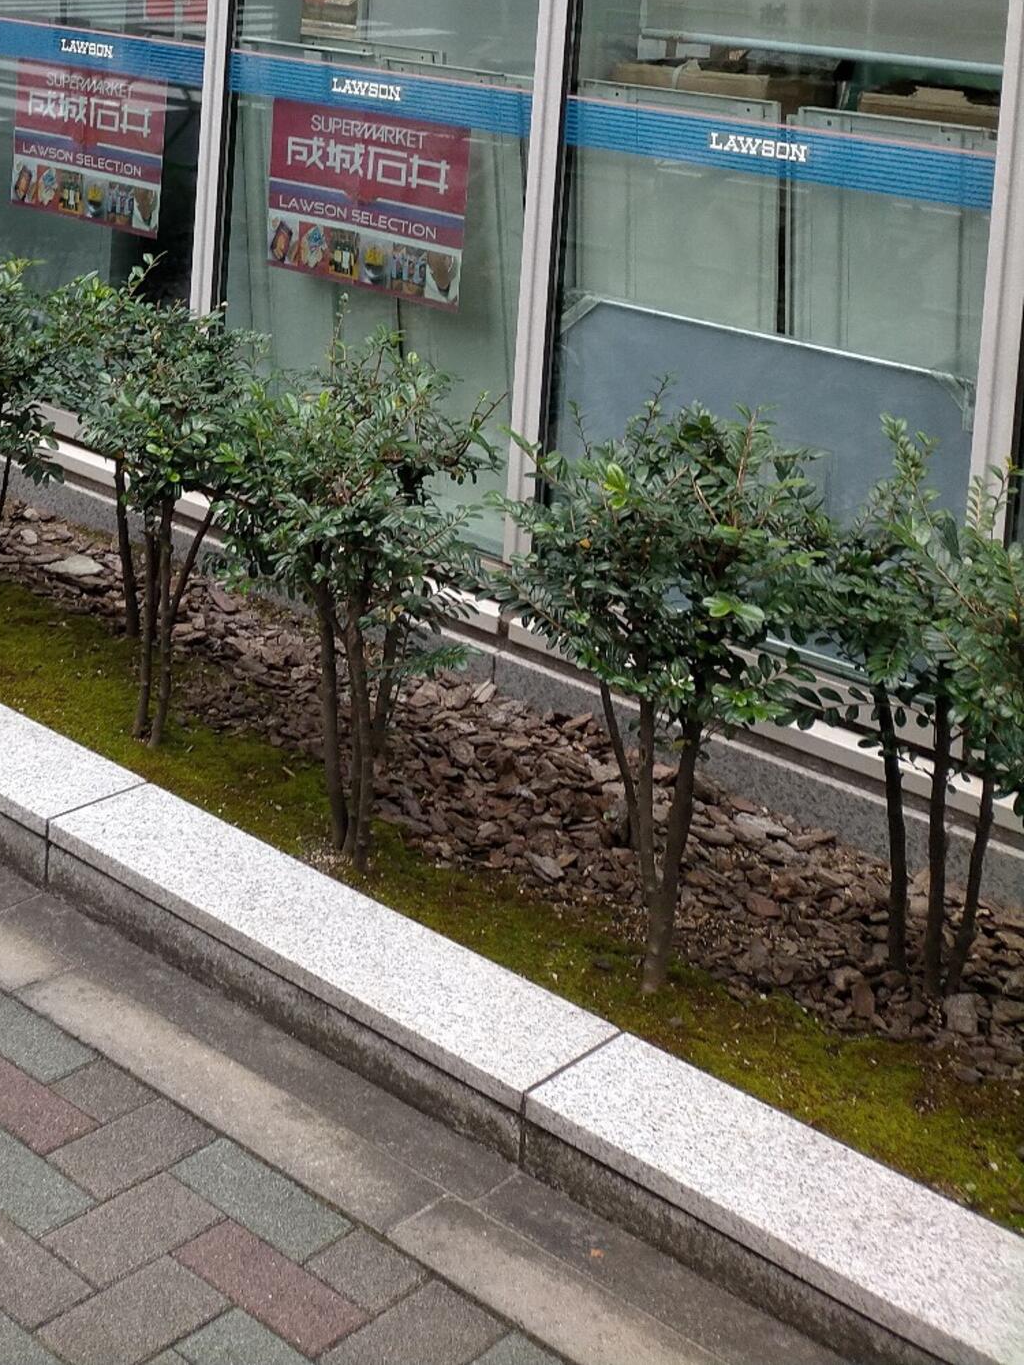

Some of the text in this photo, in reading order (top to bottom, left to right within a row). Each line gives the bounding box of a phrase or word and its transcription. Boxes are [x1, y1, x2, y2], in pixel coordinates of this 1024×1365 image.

[60, 38, 114, 60] LAWSON
[46, 71, 135, 101] SUPERMARKET
[331, 77, 402, 102] LAWSON
[28, 89, 152, 139] 成城石井
[310, 114, 426, 150] SUPERMARKET
[709, 132, 808, 163] LAWSON
[22, 144, 142, 178] LAWSON SELECTION
[286, 136, 451, 195] 成城石井
[279, 195, 437, 240] LAWSON SELECTION
